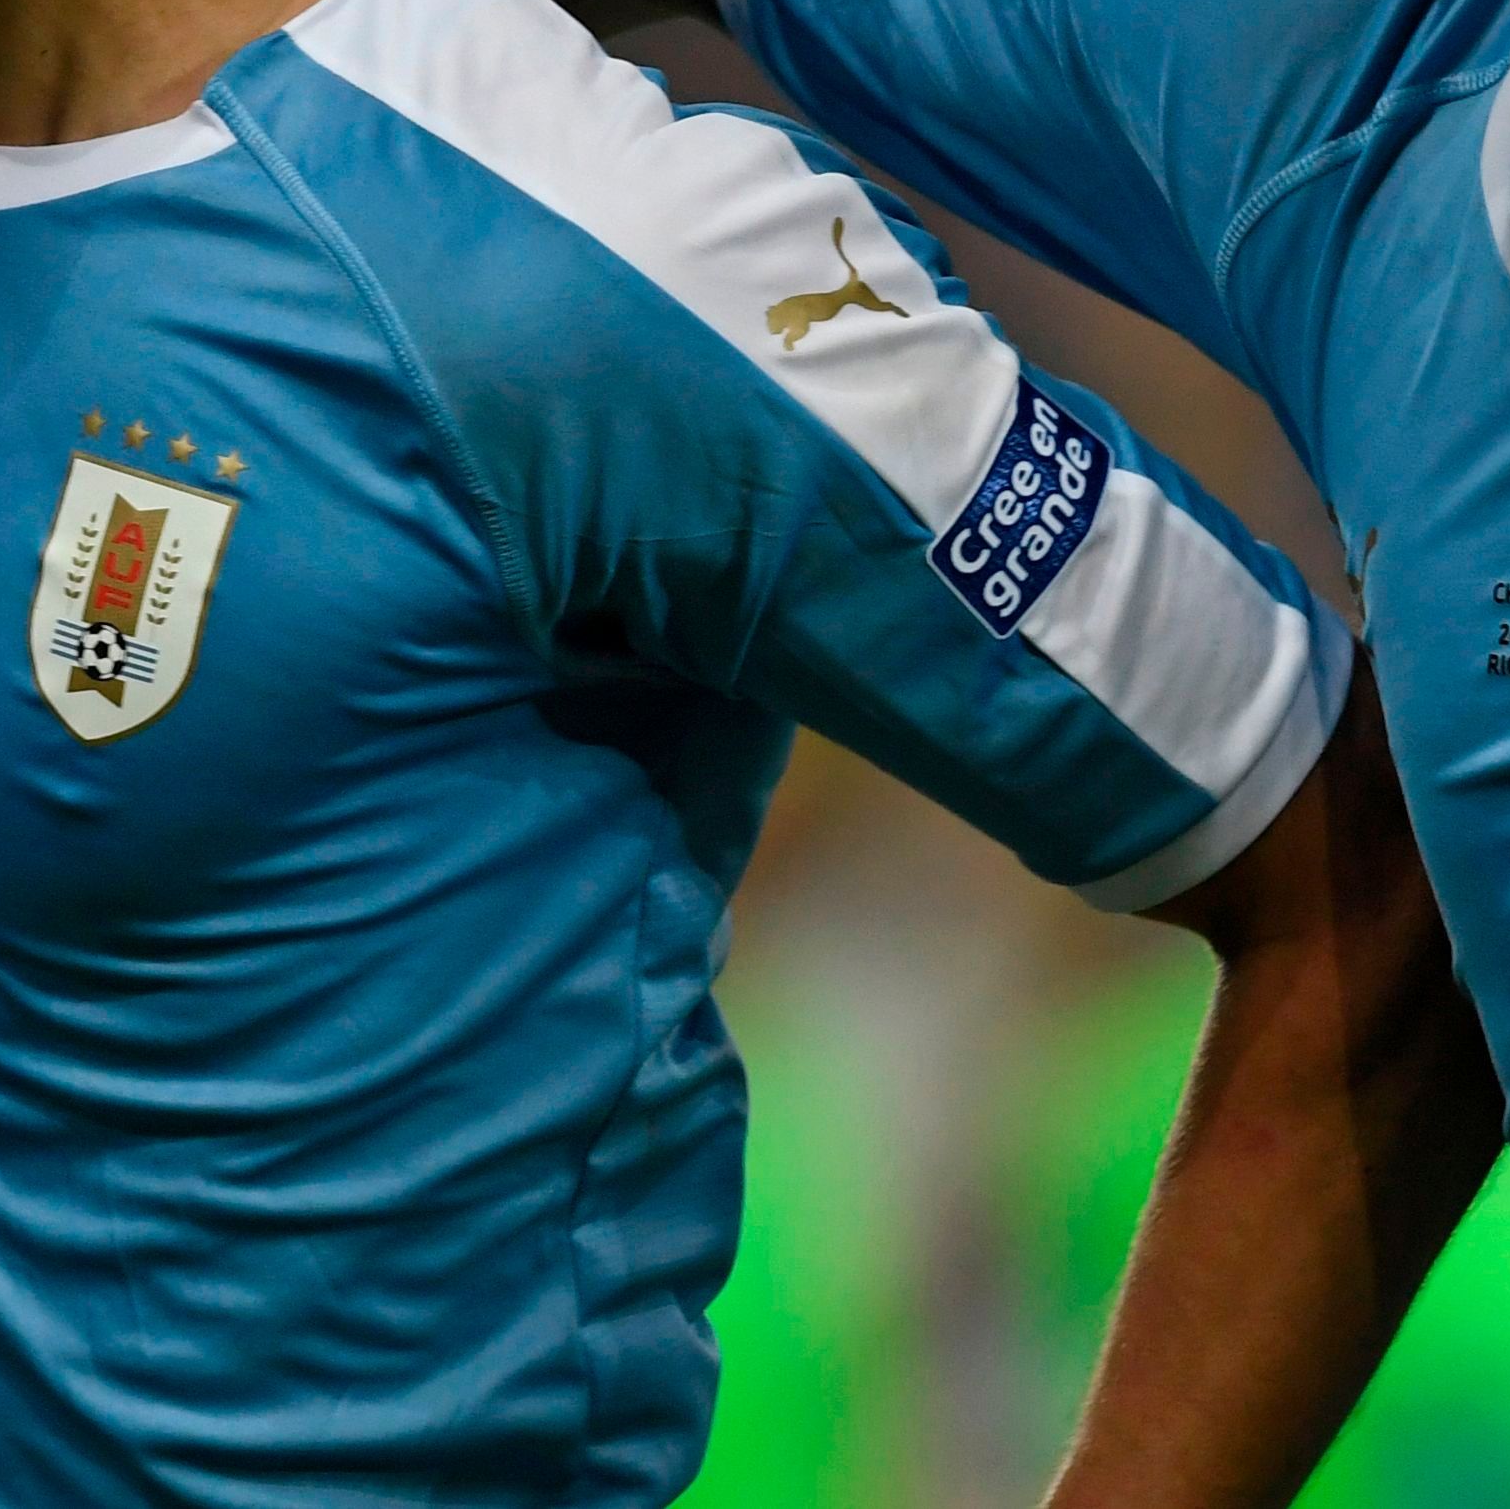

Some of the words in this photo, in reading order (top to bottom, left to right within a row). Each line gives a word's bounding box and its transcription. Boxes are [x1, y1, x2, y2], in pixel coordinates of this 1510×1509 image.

[94, 522, 146, 610] AUF
[950, 460, 1041, 574] Cree
[1029, 398, 1059, 457] en
[982, 437, 1092, 618] grande
